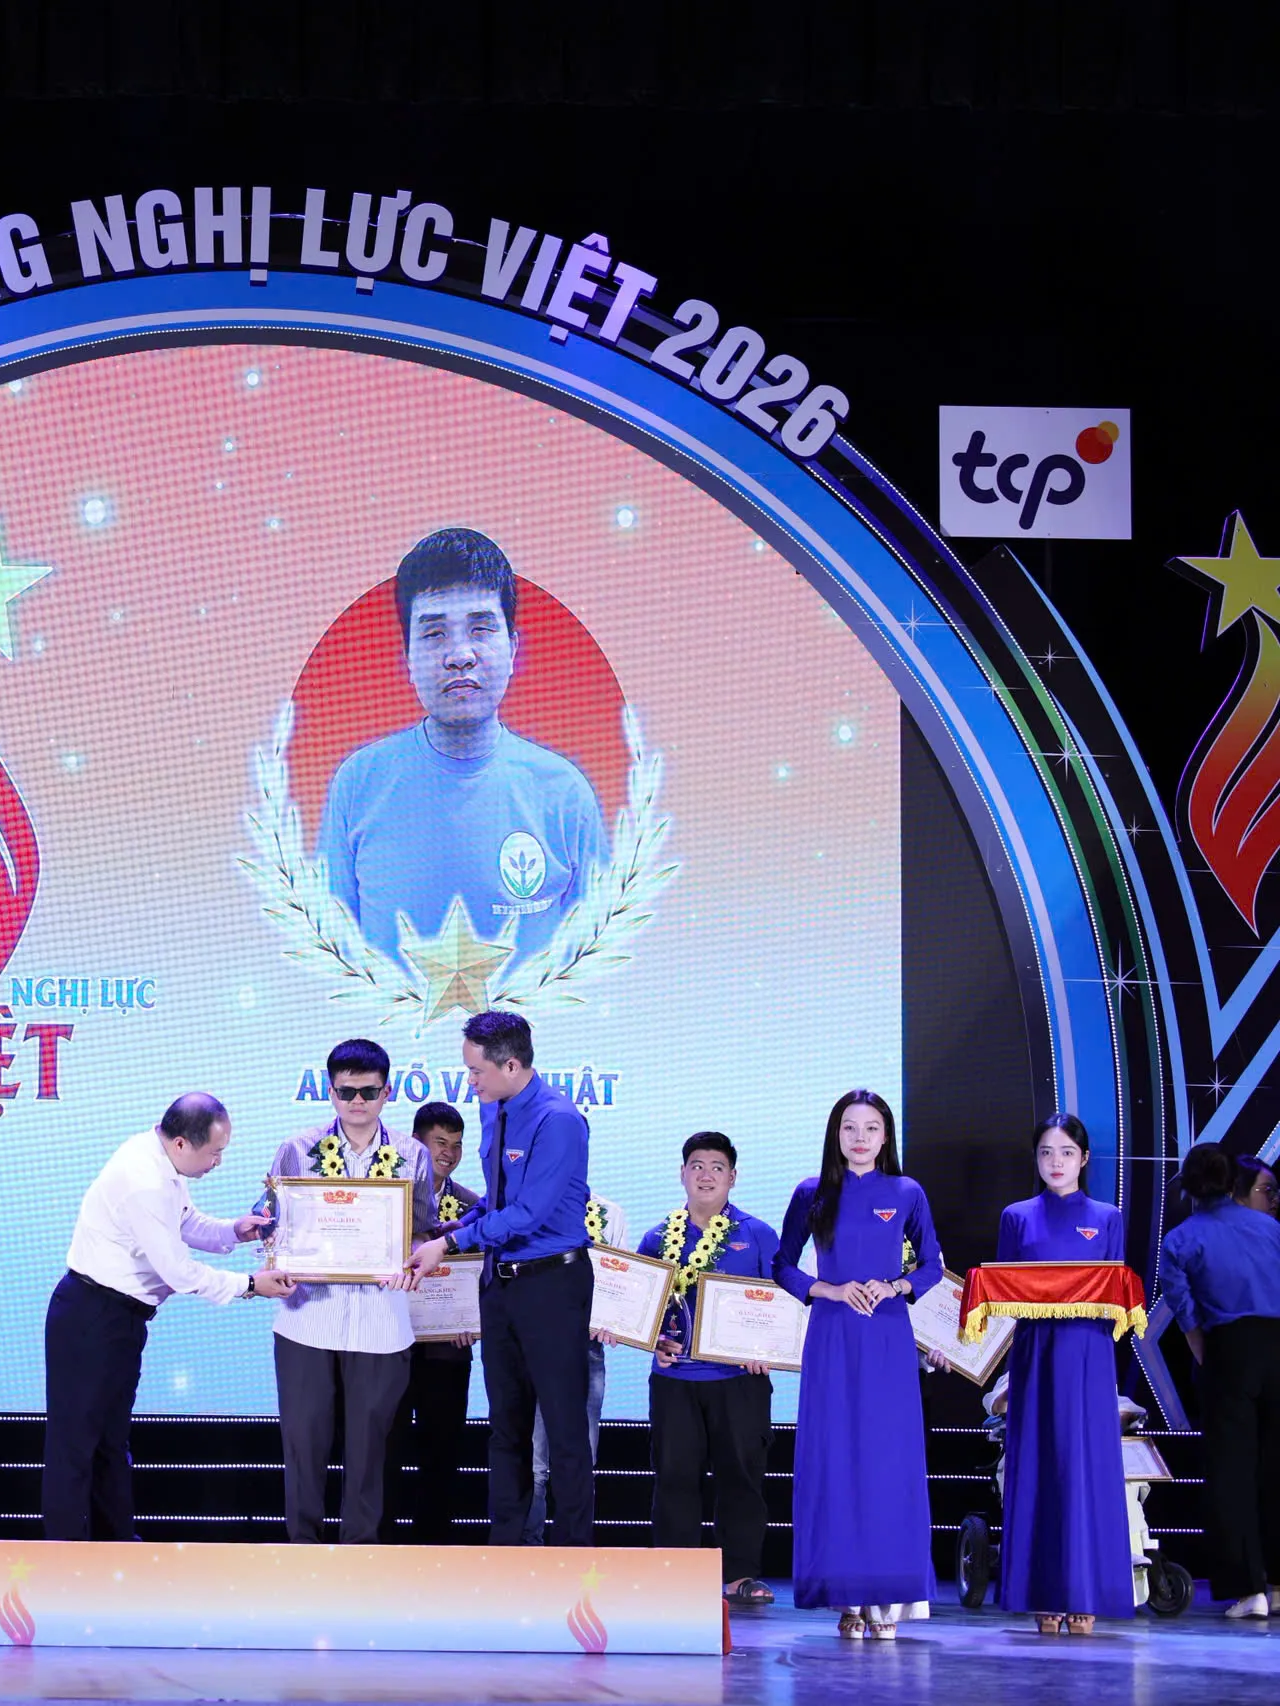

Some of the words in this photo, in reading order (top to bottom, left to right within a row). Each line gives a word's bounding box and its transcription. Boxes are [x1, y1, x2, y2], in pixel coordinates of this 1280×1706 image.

[70, 186, 271, 283] NGHỊ
[300, 187, 454, 291] LỰC
[480, 217, 659, 343] VIỆT
[650, 298, 852, 457] 2026
[952, 430, 1086, 530] tcp
[11, 977, 90, 1015] NGHỊ
[101, 977, 156, 1016] LỰC
